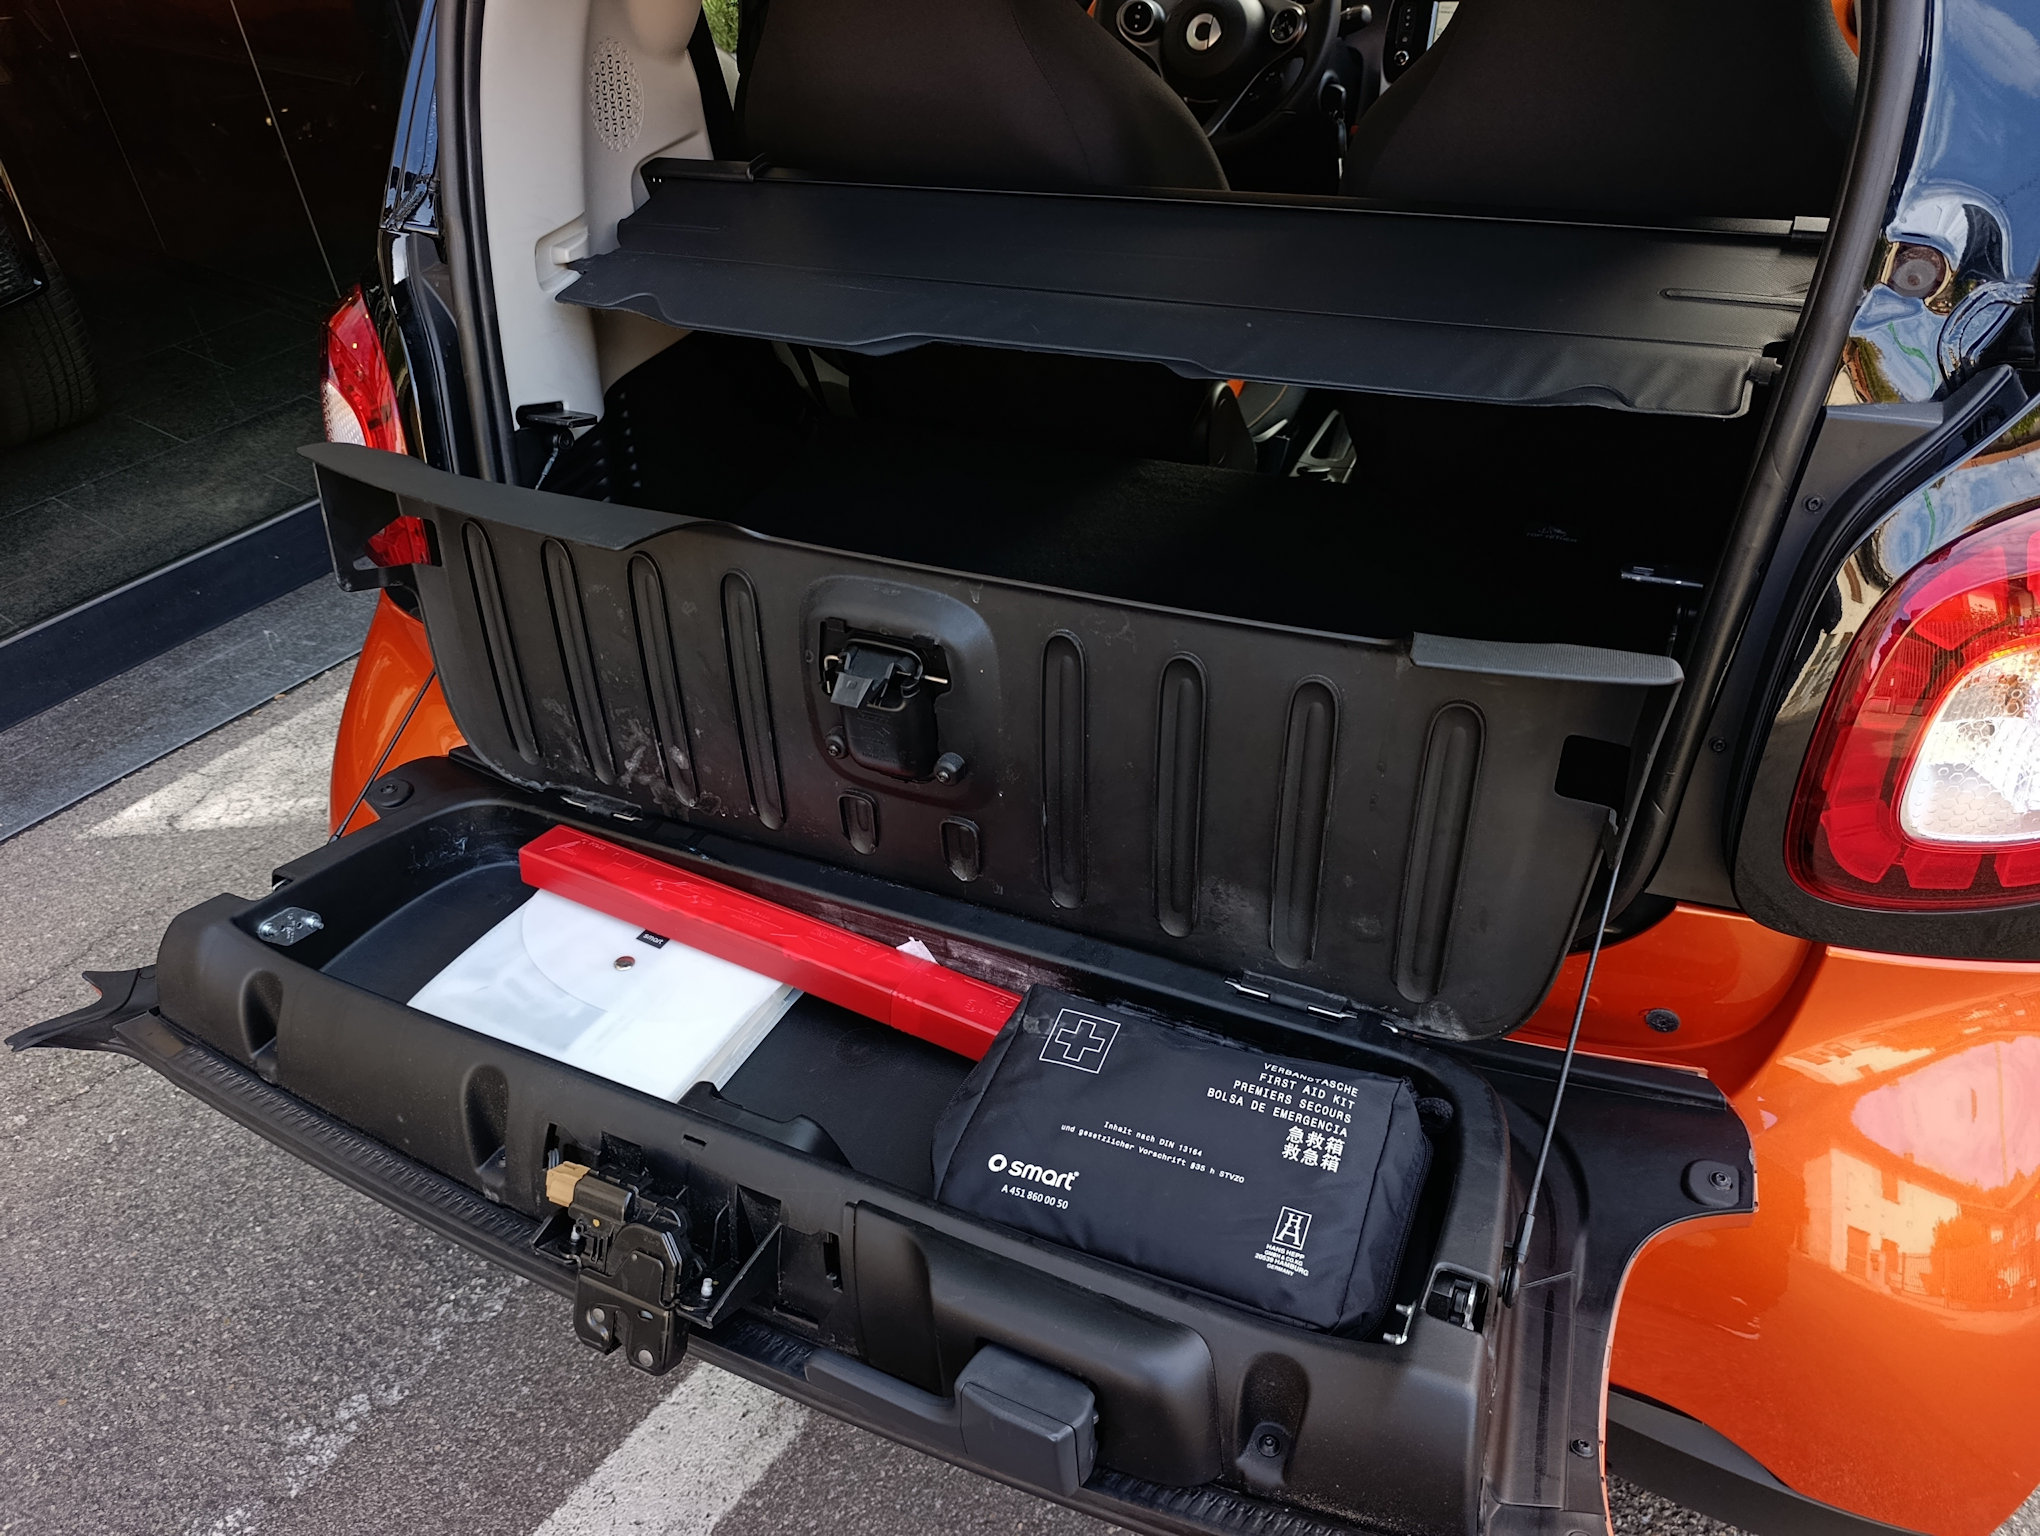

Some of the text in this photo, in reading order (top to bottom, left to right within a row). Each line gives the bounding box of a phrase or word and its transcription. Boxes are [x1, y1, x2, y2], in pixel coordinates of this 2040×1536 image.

[643, 934, 664, 944] smart
[1259, 1073, 1355, 1110] FIRST AID KIT
[1264, 1063, 1359, 1097] VERBANDTASCHE
[1207, 1087, 1348, 1137] BOLSA DE EMERGENCIA
[1233, 1080, 1352, 1123] PREMIERS SECOURS
[1061, 1124, 1075, 1133] und
[1078, 1128, 1135, 1151] gesetzlicher
[1138, 1146, 1186, 1167] Vorschrift
[1209, 1167, 1215, 1175] h
[1104, 1121, 1202, 1157] Inhalt nach DIN 13164
[1286, 1126, 1345, 1156] 急救箱
[1282, 1143, 1341, 1173] 救急箱
[1001, 1184, 1069, 1209] A 451 860 00 50
[1254, 1252, 1309, 1277] 20539 HAMBURG
[1266, 1243, 1305, 1259] HANS HEPP
[1266, 1263, 1294, 1277] GERMANY
